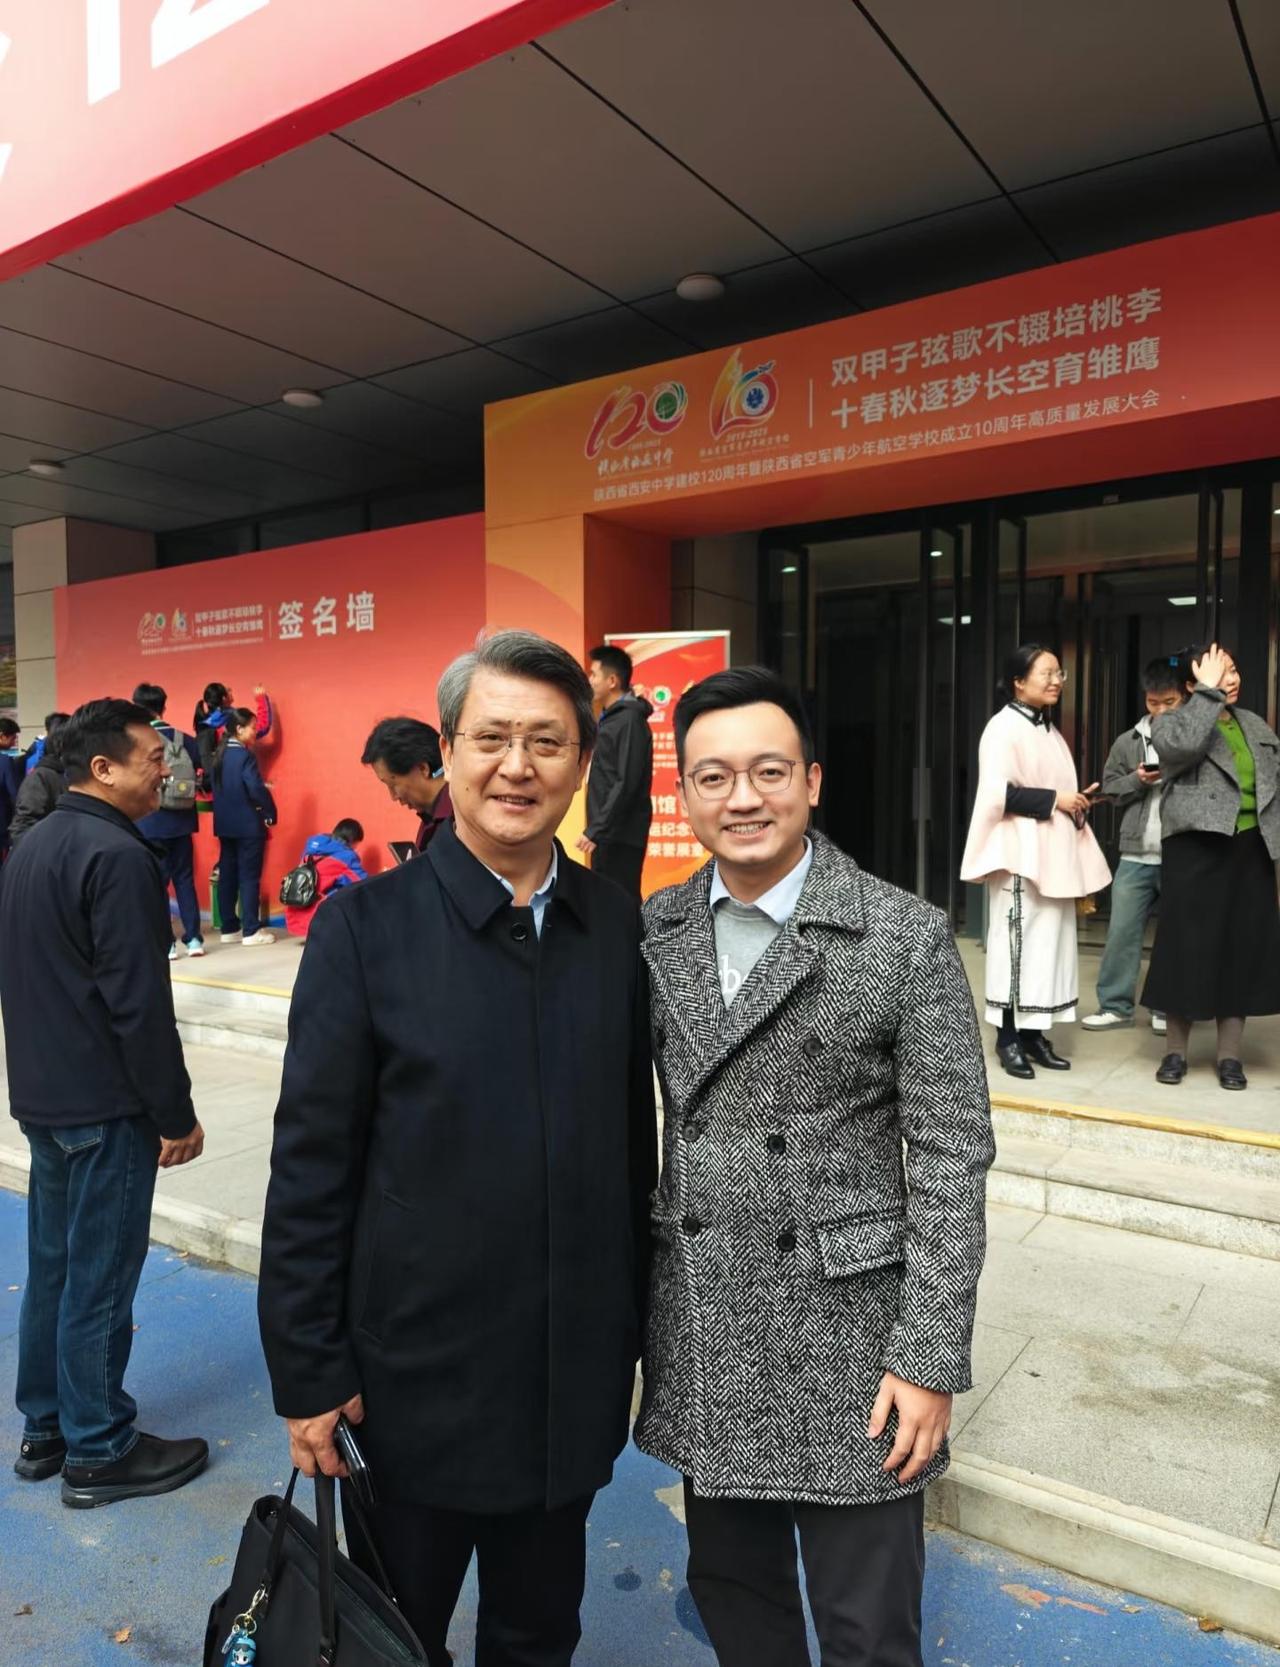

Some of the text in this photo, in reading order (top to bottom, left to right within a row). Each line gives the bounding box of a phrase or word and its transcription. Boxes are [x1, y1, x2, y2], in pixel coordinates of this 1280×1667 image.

[831, 287, 1161, 387] 双甲子弦歌不辍培桃李
[831, 336, 1161, 429] 十春秋逐梦长空育雏鹰
[593, 388, 1161, 502] 陕西省西安中学建校120周年暨陕西省空军青少年航空学校成立10周年高质量发展大会
[277, 590, 376, 641] 签名墙
